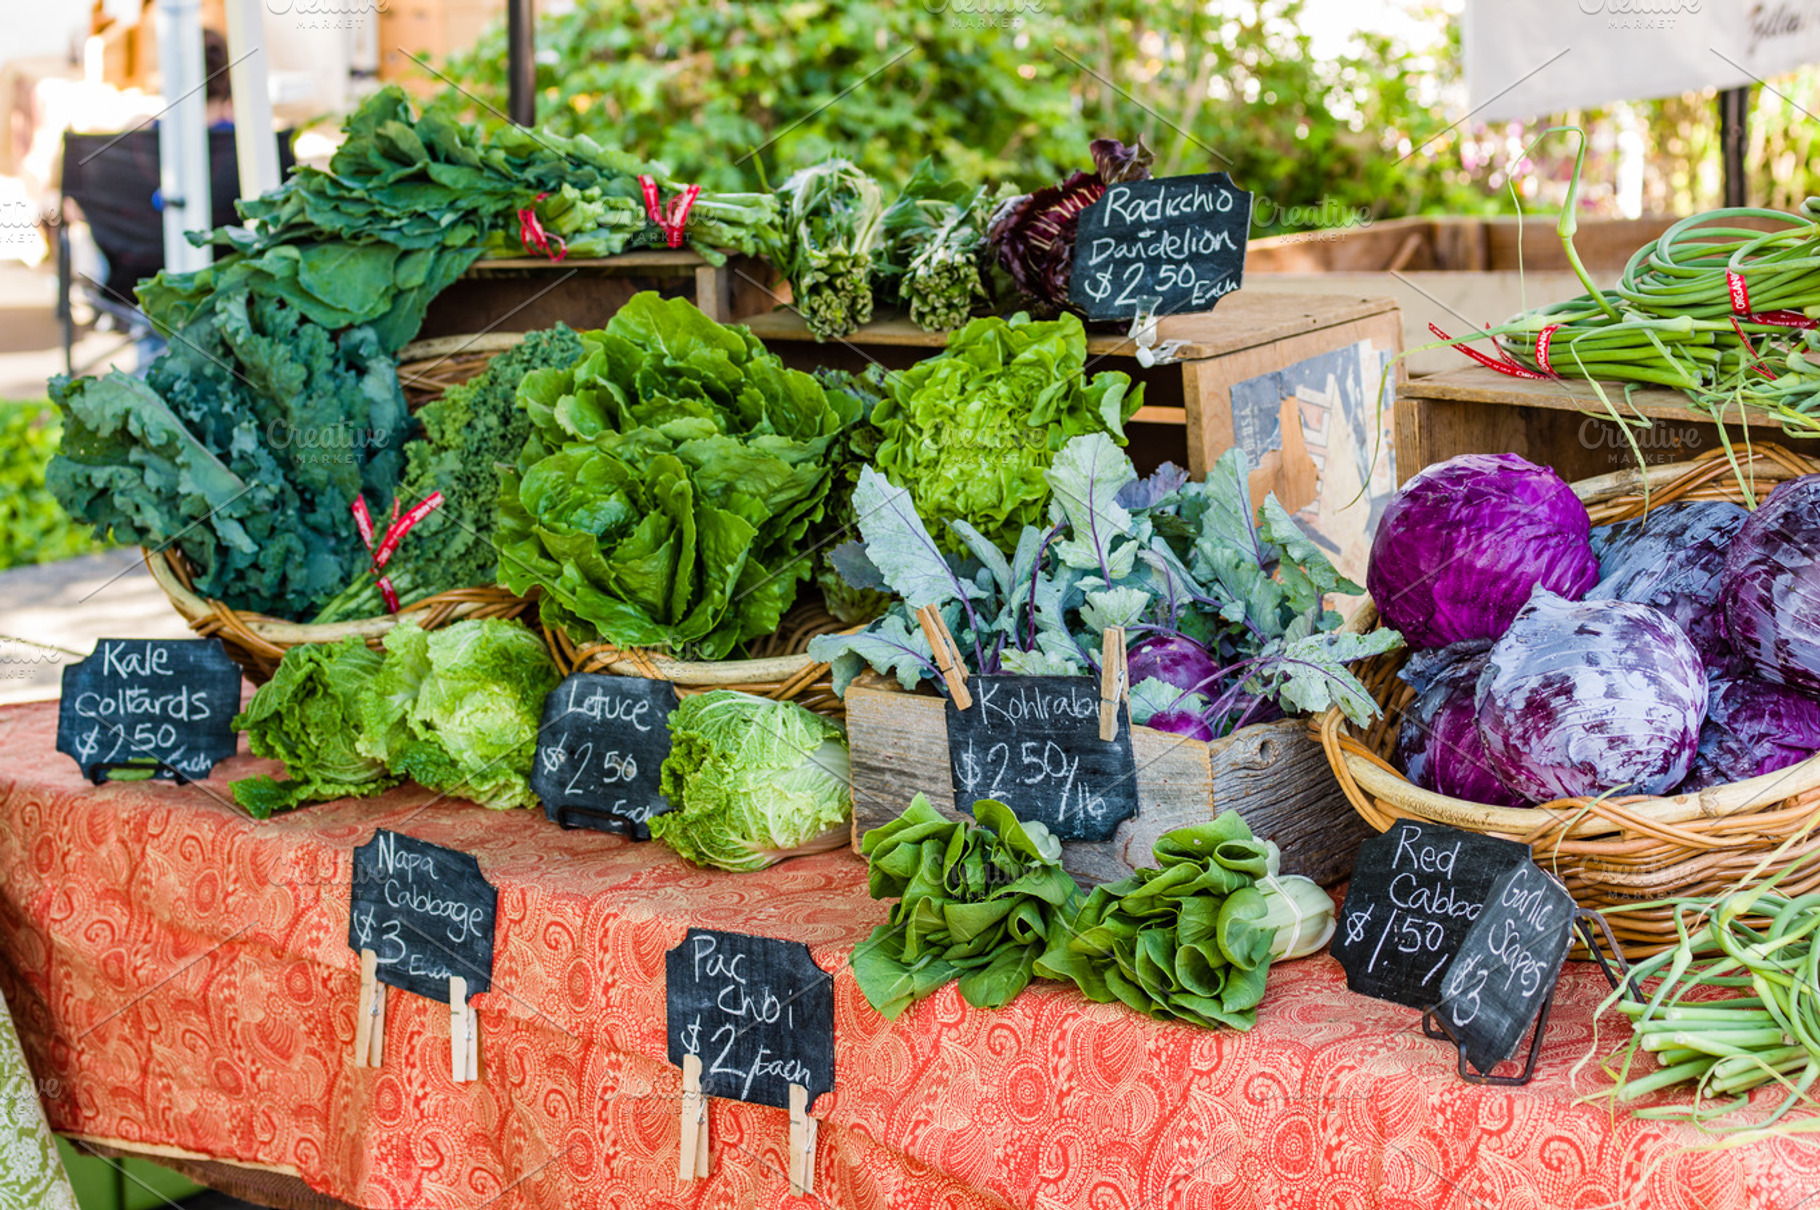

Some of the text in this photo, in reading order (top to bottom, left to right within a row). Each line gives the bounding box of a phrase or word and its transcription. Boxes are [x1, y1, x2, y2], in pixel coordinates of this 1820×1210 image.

[1103, 184, 1233, 227] Radicchio
[1089, 227, 1238, 266] Dandelion
[1536, 327, 1552, 372] ORGANIC
[103, 641, 174, 679] Kale
[978, 678, 1100, 726] Kohlrabi
[378, 832, 439, 883] Napa
[1392, 825, 1461, 880] Red
[385, 879, 484, 943] Cabbage
[1502, 868, 1553, 931] Garlic
[692, 934, 746, 985] Pac
